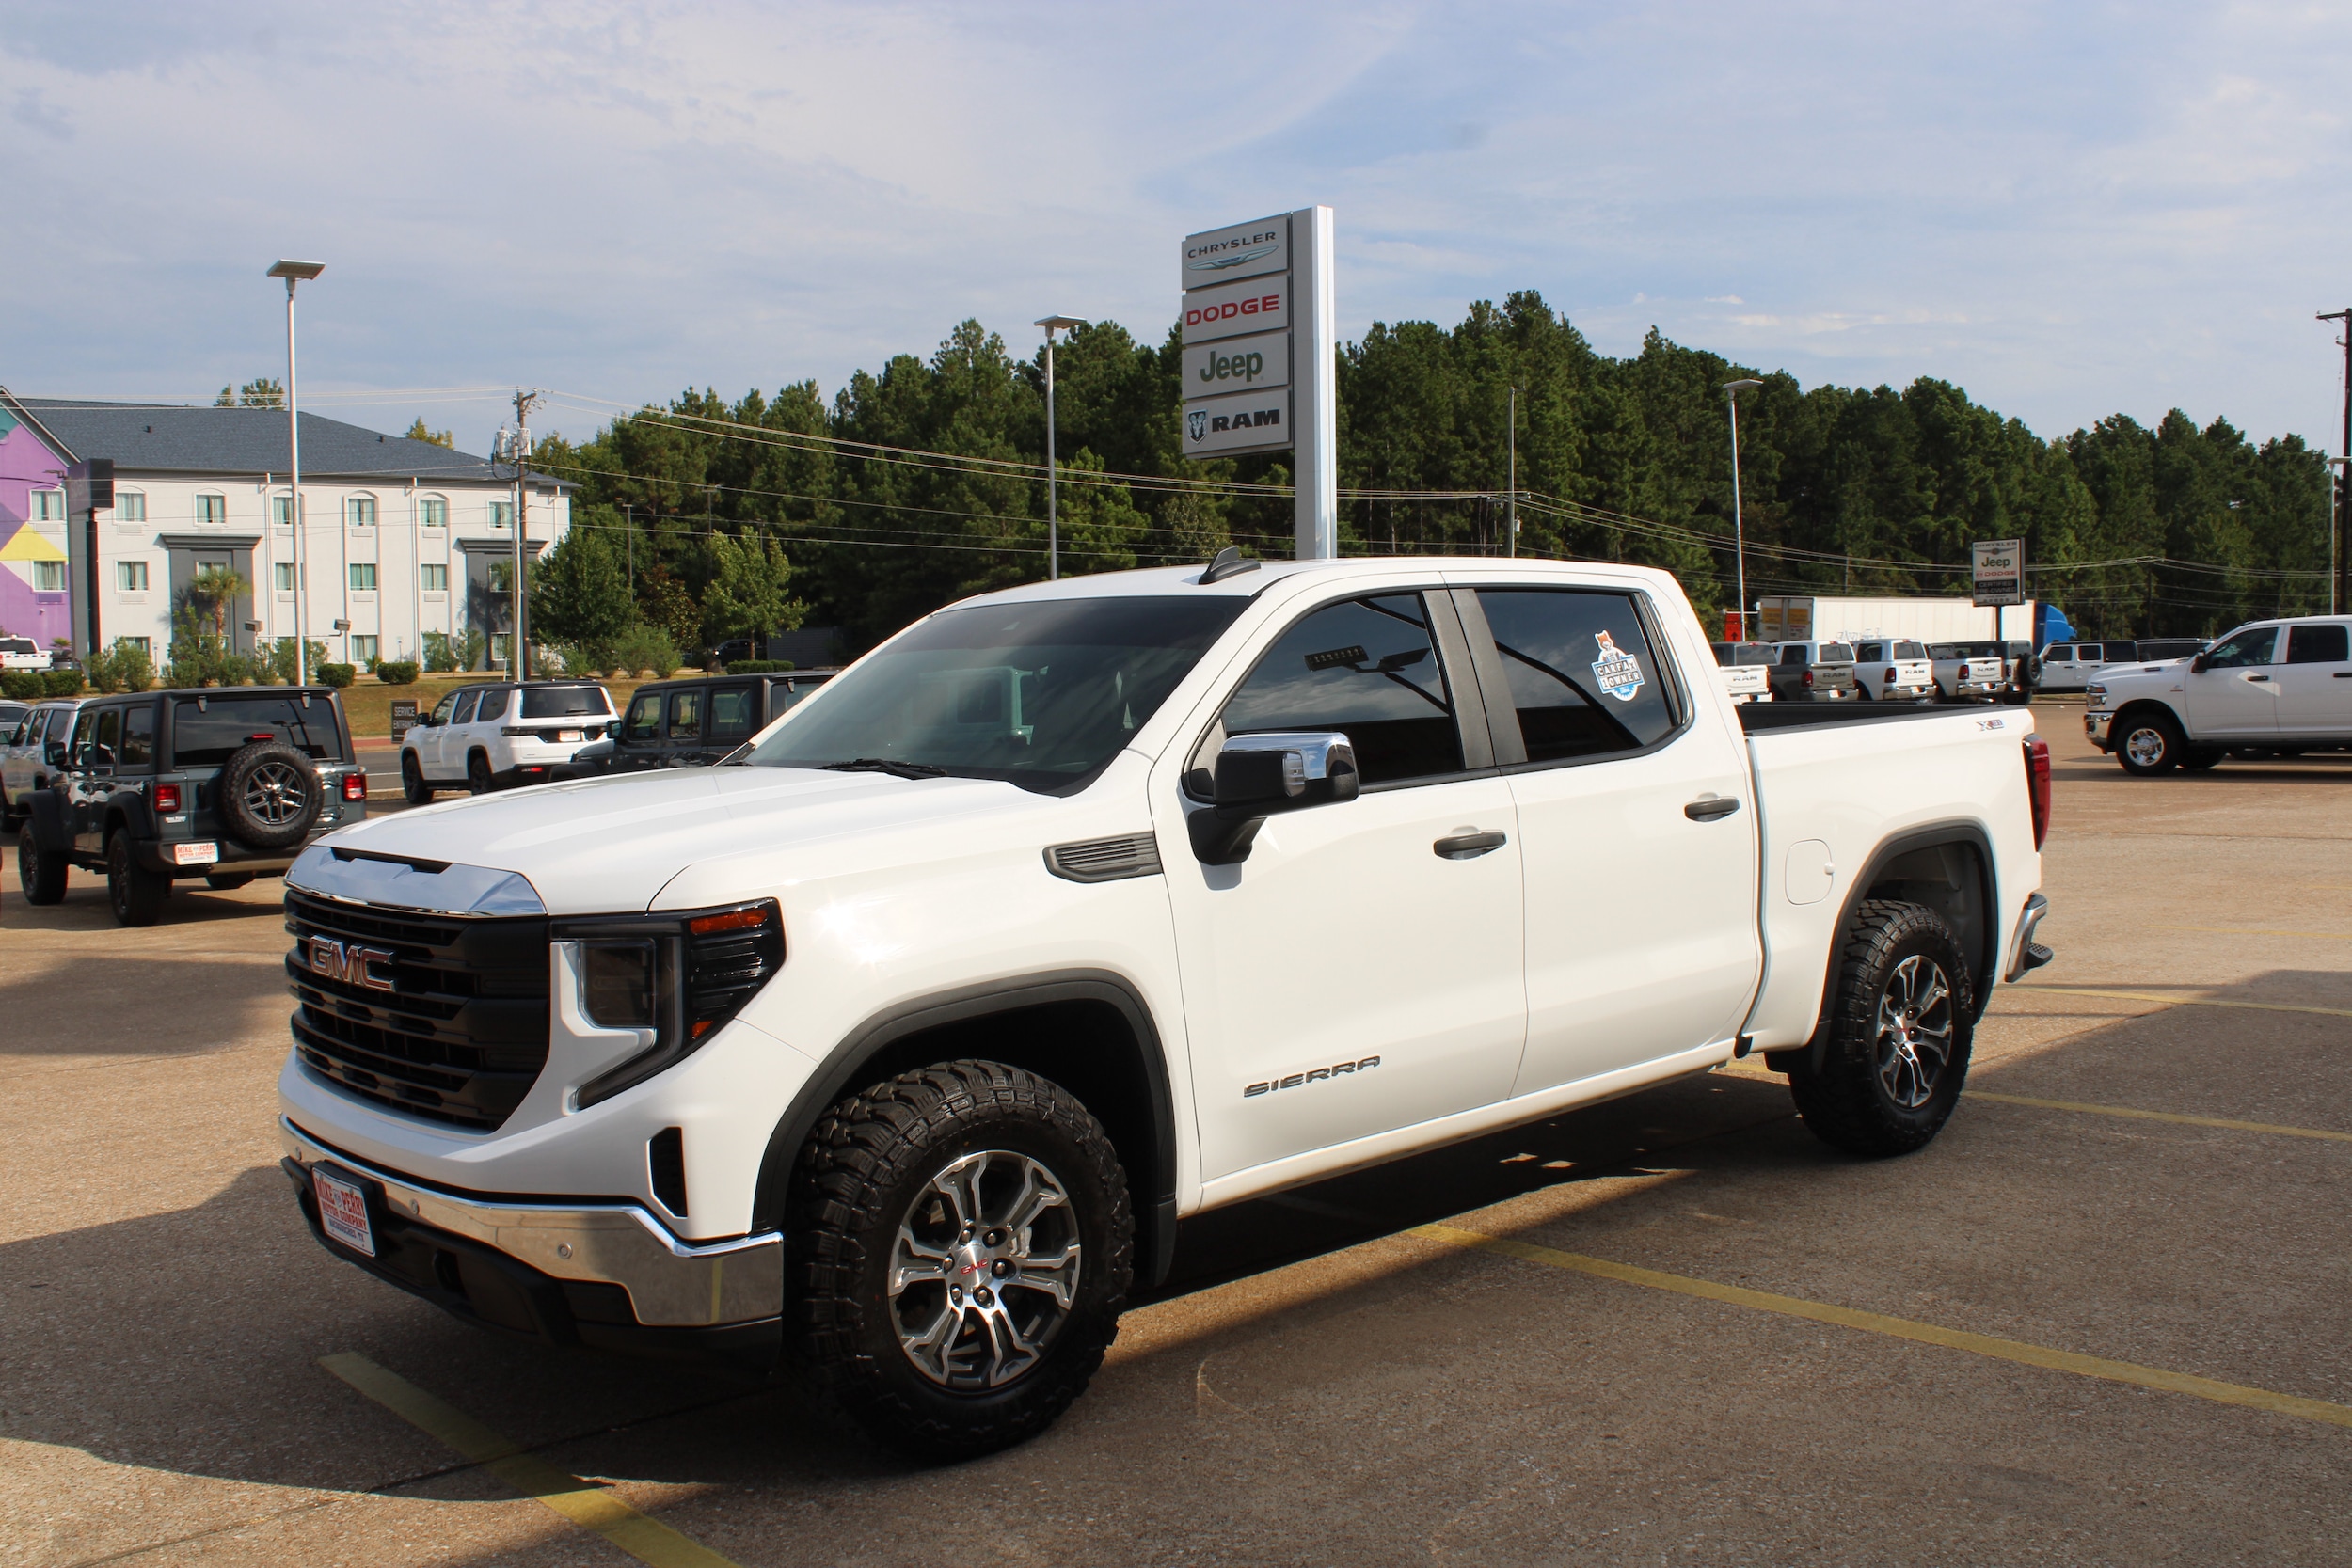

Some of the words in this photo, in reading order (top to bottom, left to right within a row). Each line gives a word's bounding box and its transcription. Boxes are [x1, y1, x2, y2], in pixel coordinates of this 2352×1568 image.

[1187, 231, 1277, 259] CHRYSLER
[1186, 294, 1279, 326] DODGE
[1200, 350, 1263, 383] Jeep
[1212, 408, 1280, 433] RAM
[1981, 557, 2010, 568] Jeep
[1597, 660, 1637, 676] CARFAX
[394, 706, 415, 716] SERVICE
[310, 935, 394, 992] GMC
[1244, 1055, 1381, 1098] SIERRA
[315, 1176, 336, 1205] MIKE
[340, 1190, 366, 1219] PERRY
[321, 1199, 340, 1217] MOTOR
[340, 1210, 367, 1231] COMPANY
[961, 1257, 989, 1275] GMC
